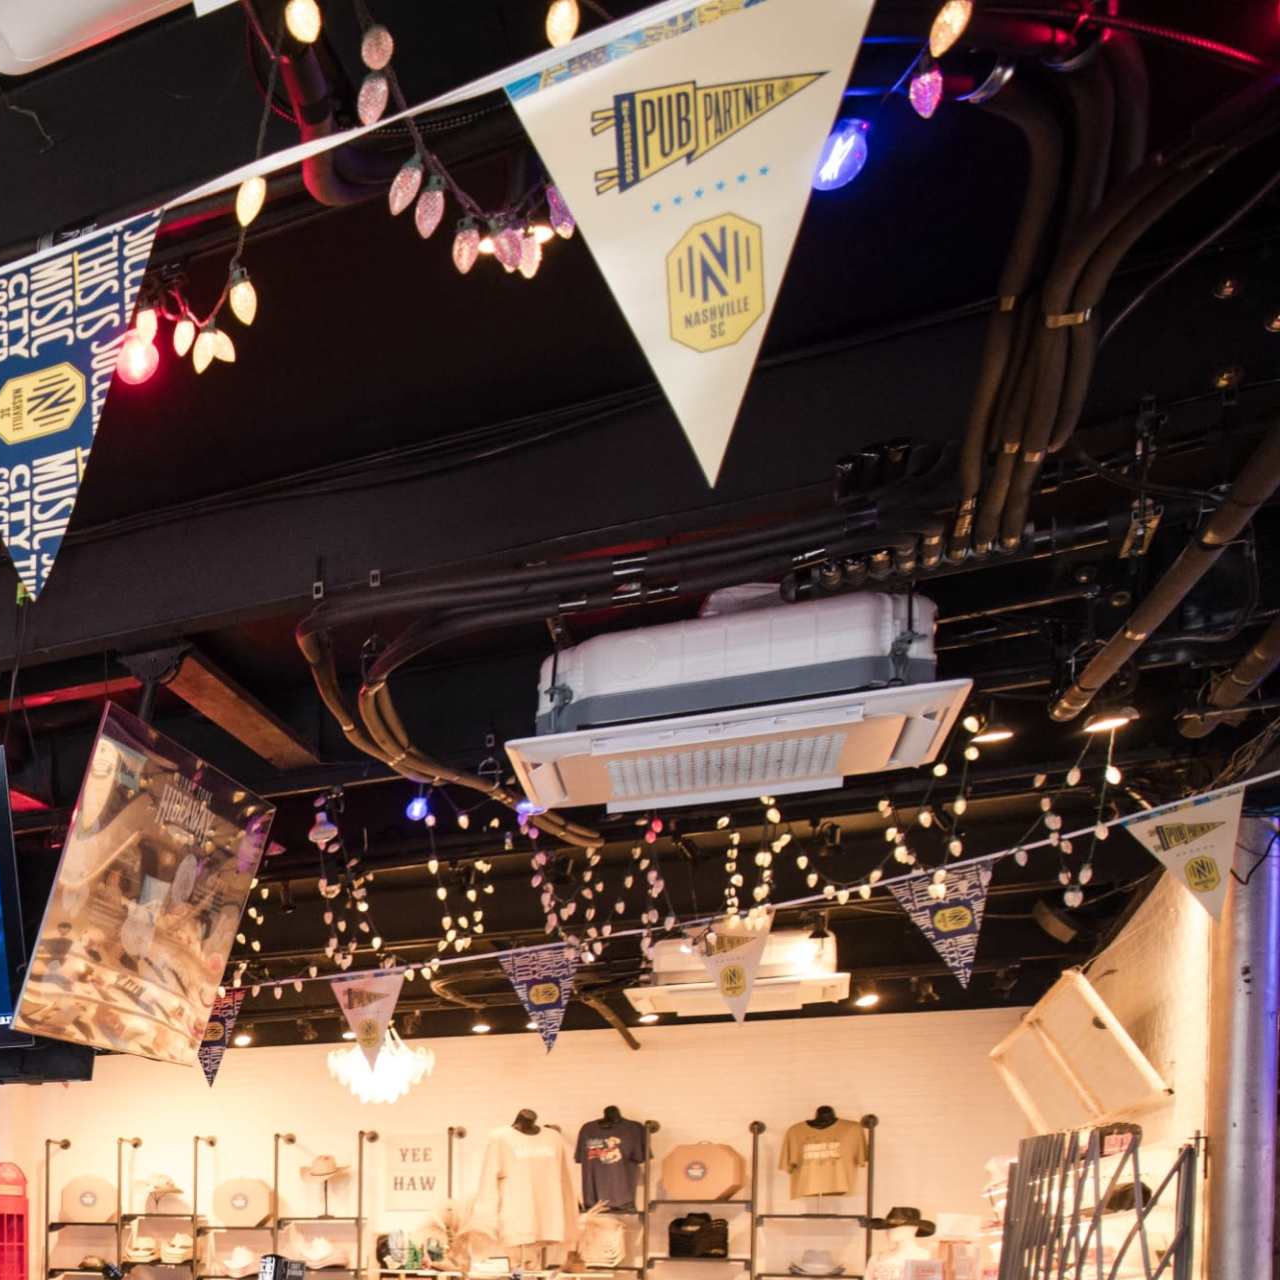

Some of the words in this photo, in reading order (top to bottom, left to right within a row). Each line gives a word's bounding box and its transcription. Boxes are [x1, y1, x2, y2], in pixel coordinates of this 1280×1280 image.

[641, 91, 690, 169] PUB
[703, 83, 775, 145] PARTNER
[76, 235, 119, 306] THIS
[7, 273, 30, 359] CITY
[31, 255, 73, 358] MUSIC
[76, 308, 120, 340] IS
[684, 296, 751, 328] NASHVILLE
[709, 323, 726, 338] SC
[0, 408, 11, 420] SC
[12, 388, 24, 432] NASHVILLE
[9, 464, 31, 550] CITY
[32, 448, 78, 550] MUSIC
[400, 1147, 432, 1162] YEE
[393, 1175, 436, 1191] HAW
